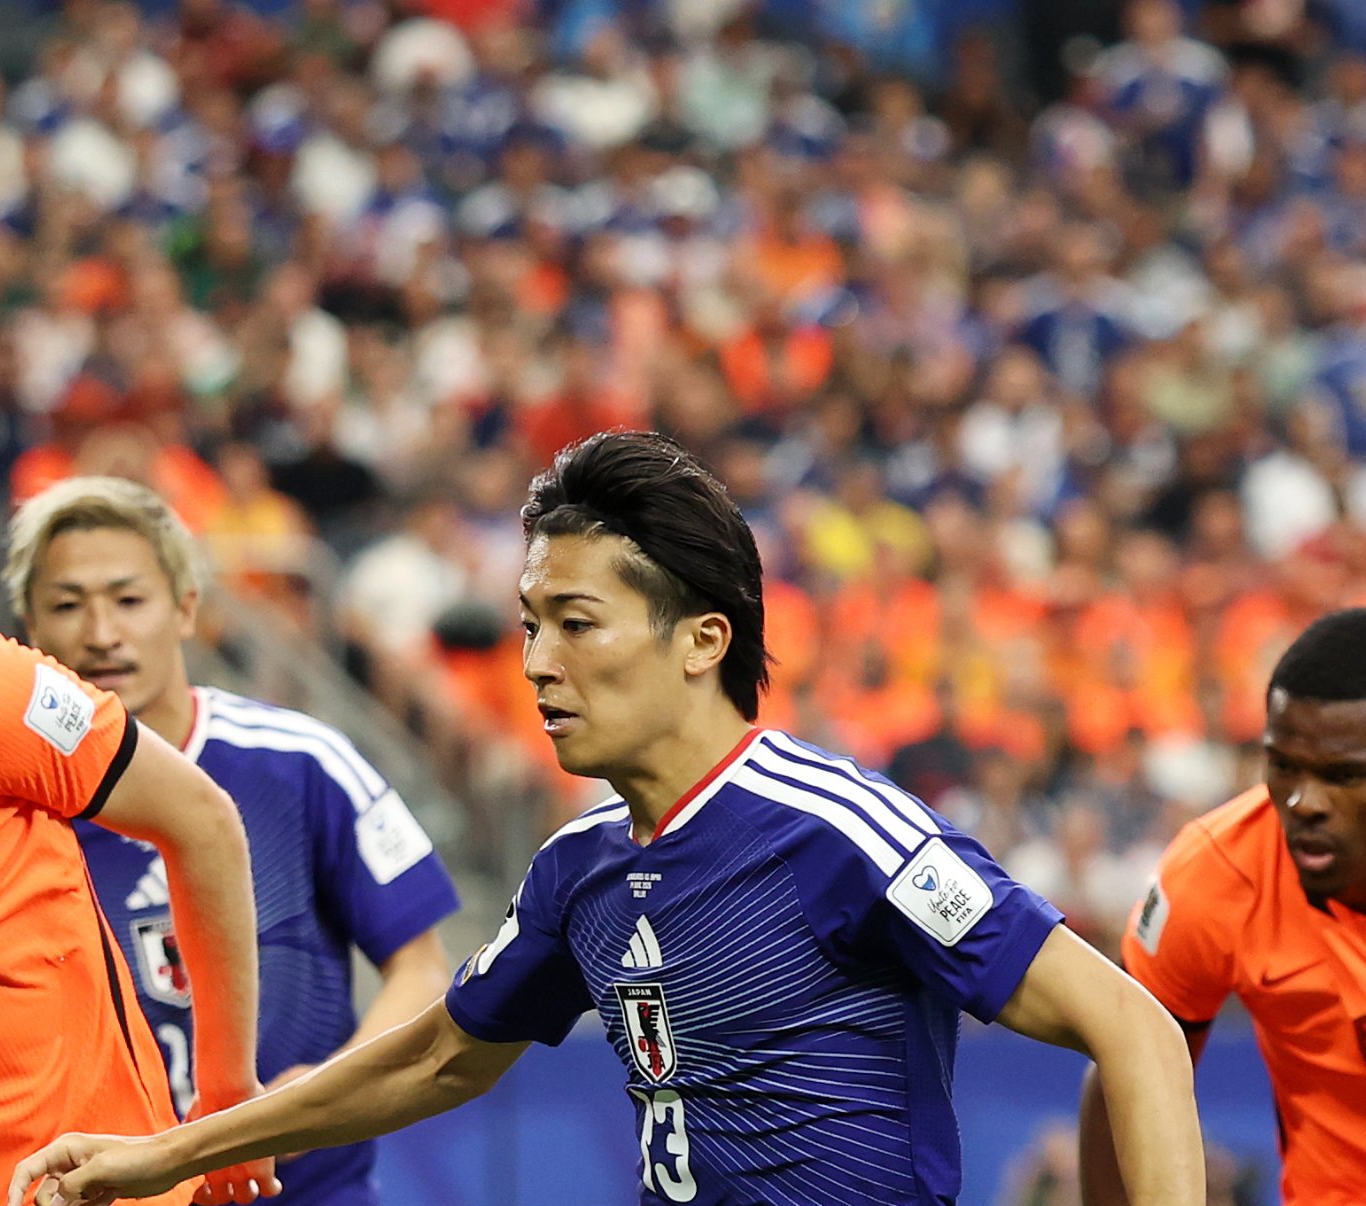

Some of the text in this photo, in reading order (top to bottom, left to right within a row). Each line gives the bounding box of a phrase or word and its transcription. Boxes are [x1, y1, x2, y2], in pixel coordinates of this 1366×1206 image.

[939, 889, 972, 922] PEACE
[955, 907, 973, 923] FIFA
[627, 988, 653, 996] JAPAN
[625, 1088, 697, 1203] 13
